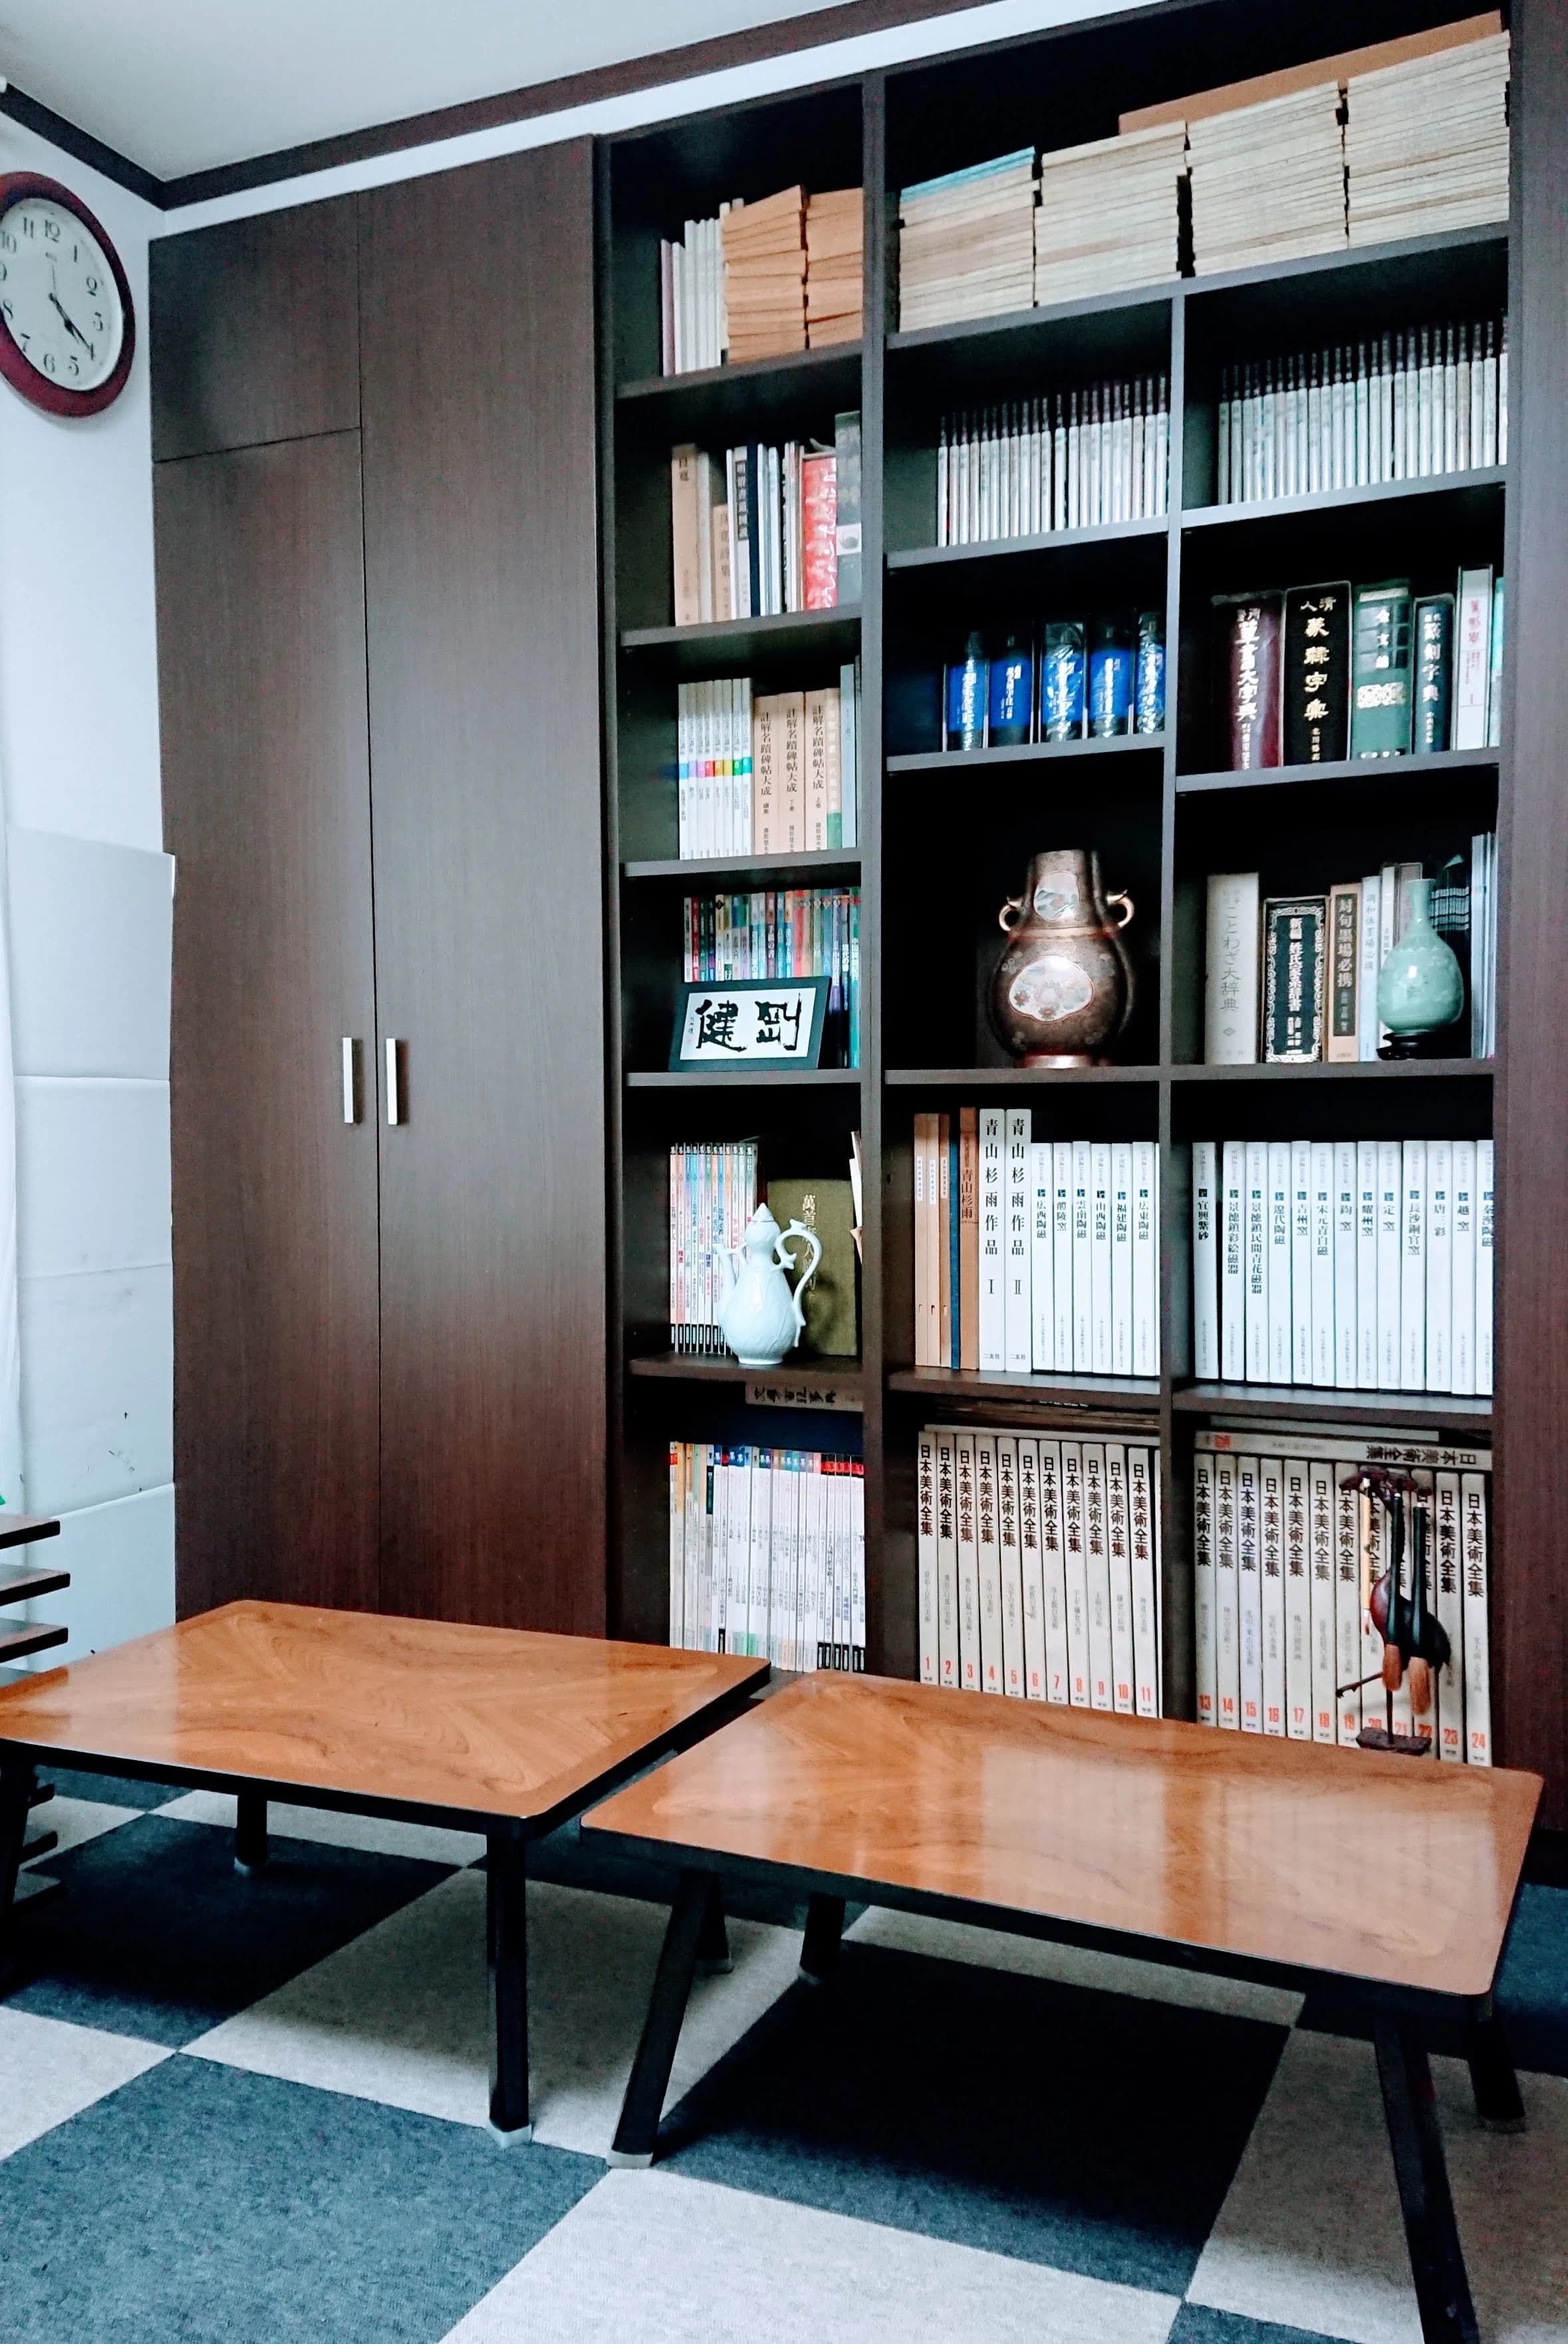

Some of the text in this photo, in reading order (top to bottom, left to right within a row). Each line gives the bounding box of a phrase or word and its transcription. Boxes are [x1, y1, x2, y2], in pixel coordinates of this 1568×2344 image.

[23, 217, 34, 238] 11
[44, 219, 60, 242] 12
[1, 231, 17, 253] 10
[73, 245, 77, 263] 1
[86, 277, 97, 297] 2
[3, 299, 13, 319] 8
[92, 313, 103, 331] 3
[21, 333, 31, 352] 7
[44, 354, 55, 373] 6
[68, 356, 79, 376] 5
[1220, 906, 1241, 1012] ことわざ大辞典
[961, 1169, 974, 1219] 青山杉雨
[985, 1118, 999, 1255] 青山杉雨作品
[1011, 1118, 1025, 1255] 青山杉雨作品
[1367, 1445, 1476, 1466] 日本美術全集
[920, 1445, 933, 1536] 日本美術全集
[940, 1448, 952, 1539] 日本美術全集
[959, 1450, 973, 1543] 日本美術全集
[980, 1451, 994, 1544] 日本美術全集
[1000, 1454, 1016, 1547] 日本美術全集
[1022, 1456, 1037, 1549] 日本美術全集
[1043, 1457, 1059, 1551] 日本美術全集
[1065, 1459, 1082, 1553] 日本美術全集
[1087, 1460, 1103, 1555] 日本美術全集
[1110, 1462, 1125, 1558] 日本美術全集
[1132, 1464, 1148, 1560] 日本美術全集
[1196, 1469, 1211, 1566] 日本美術全集
[1218, 1471, 1234, 1569] 日本美術全集
[1240, 1473, 1256, 1571] 日本美術全集
[1264, 1478, 1280, 1577] 日本美術全集
[1289, 1477, 1304, 1577] 日本美術全集
[1314, 1480, 1330, 1580] 日本美術全集
[1440, 1491, 1457, 1593] 日本美術全集
[1467, 1494, 1484, 1597] 日本美術全集
[925, 1656, 930, 1670] 1
[946, 1660, 951, 1674] 2
[967, 1664, 974, 1678] 3
[989, 1666, 995, 1680] 4
[1011, 1670, 1017, 1684] 5
[1032, 1672, 1039, 1687] 6
[1053, 1675, 1060, 1690] 7
[1076, 1678, 1083, 1692] 8
[1097, 1681, 1105, 1696] 9
[1118, 1683, 1128, 1700] 10
[1141, 1687, 1151, 1702] 11
[1198, 1694, 1211, 1712] 13
[1222, 1696, 1234, 1714] 14
[1245, 1702, 1257, 1718] 15
[1293, 1708, 1305, 1724] 17
[1319, 1713, 1330, 1728] 18
[1343, 1714, 1355, 1730] 19
[1443, 1728, 1458, 1745] 23
[1471, 1732, 1486, 1750] 24
